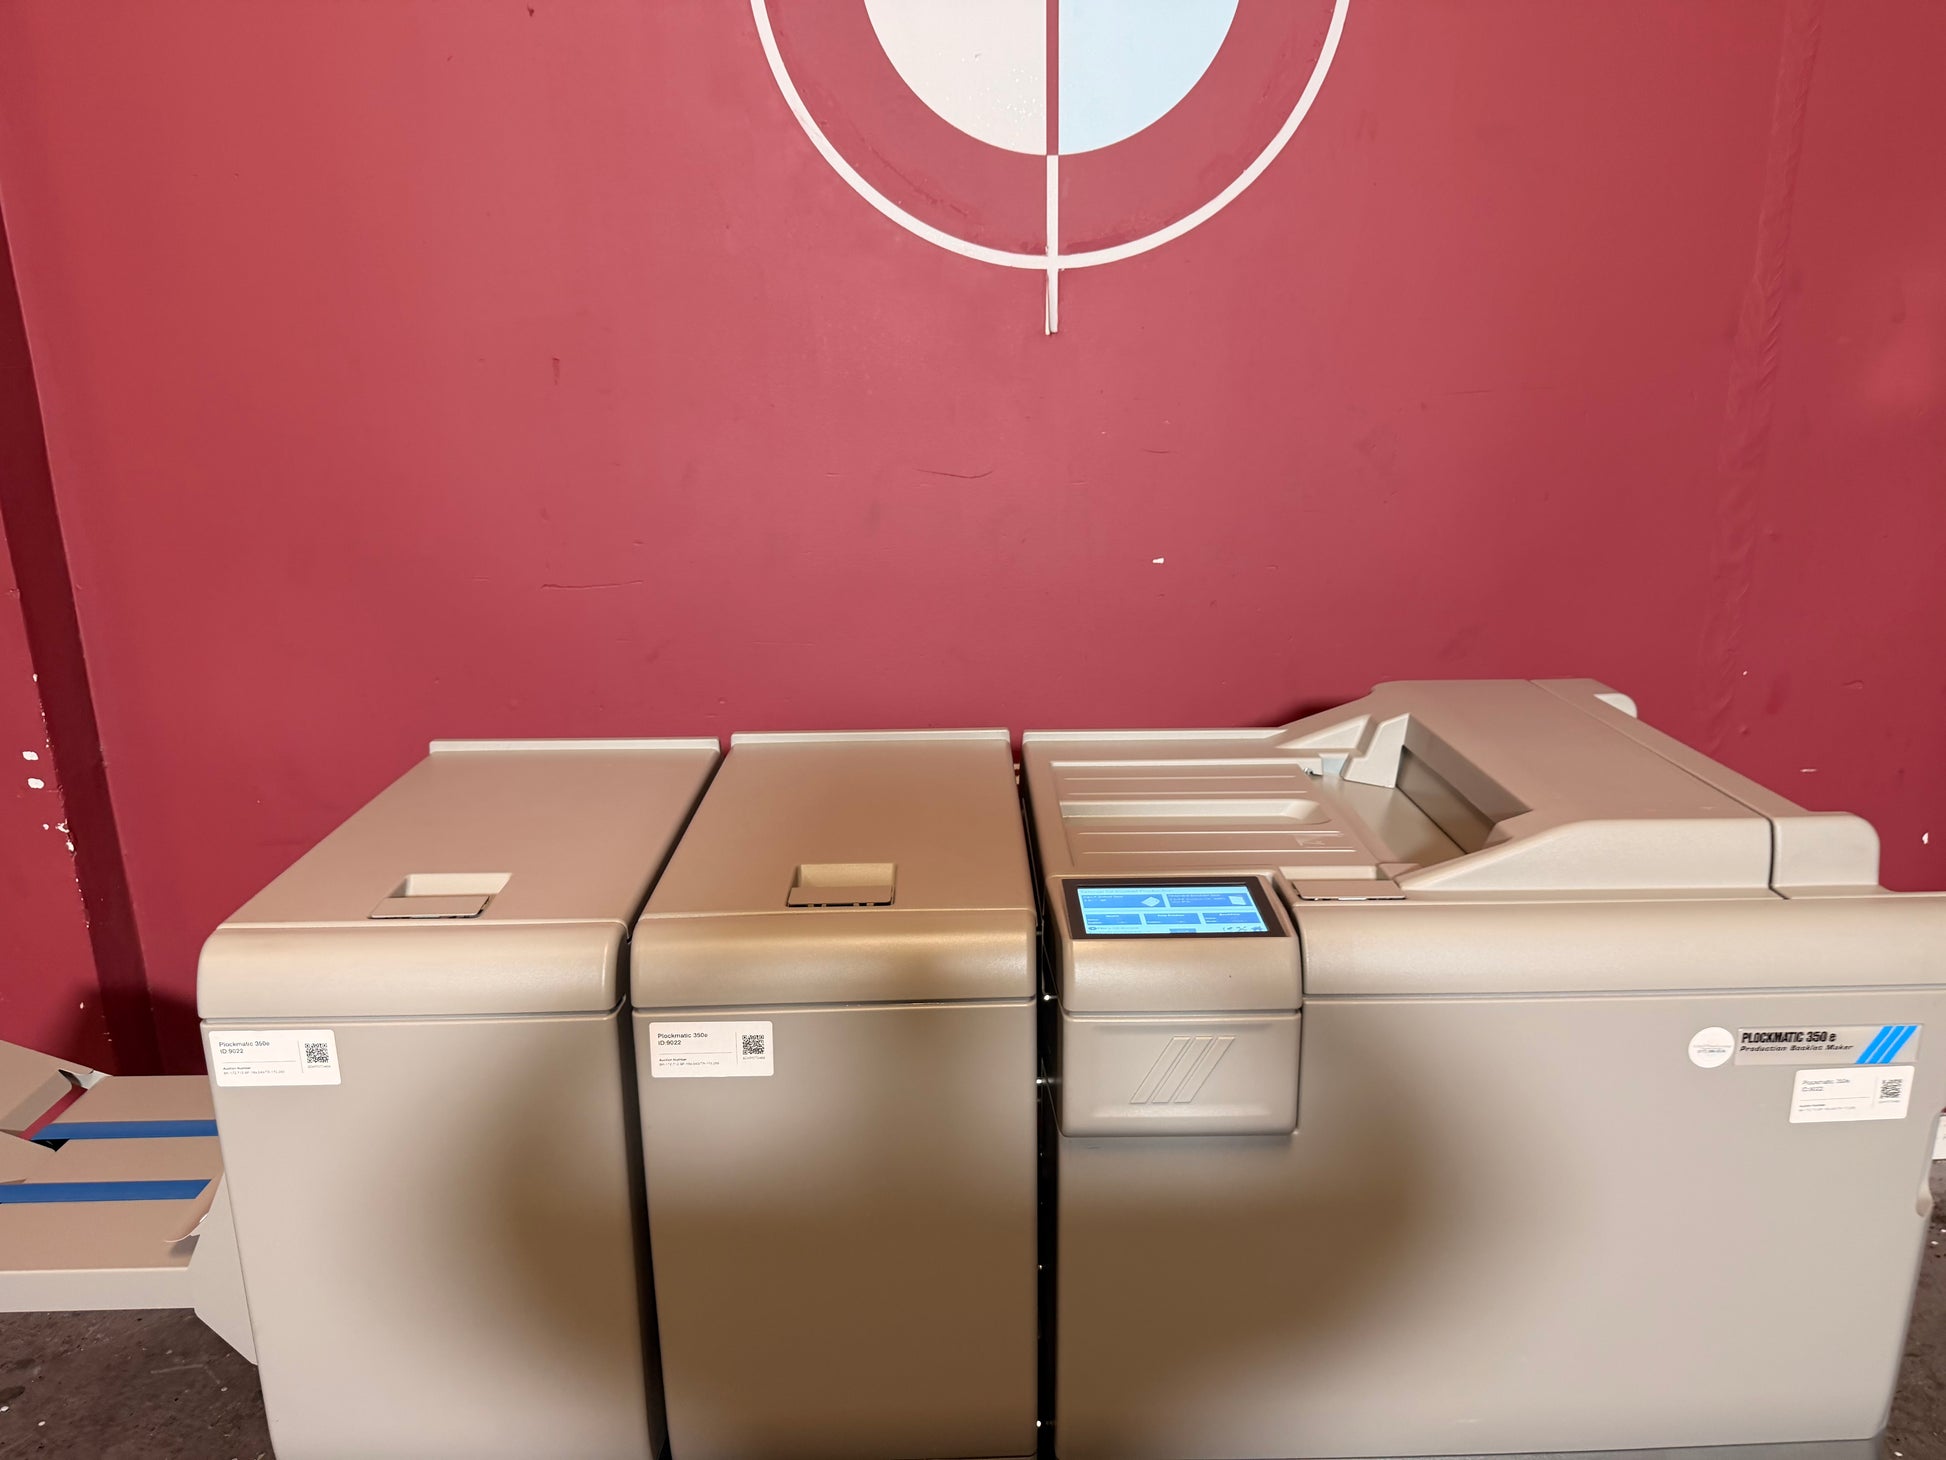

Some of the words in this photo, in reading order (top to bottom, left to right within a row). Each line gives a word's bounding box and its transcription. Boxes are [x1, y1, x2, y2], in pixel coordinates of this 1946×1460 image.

[1742, 1032, 1804, 1043] PLOCKMATIC
[1806, 1031, 1828, 1042] 350
[1829, 1033, 1836, 1042] e
